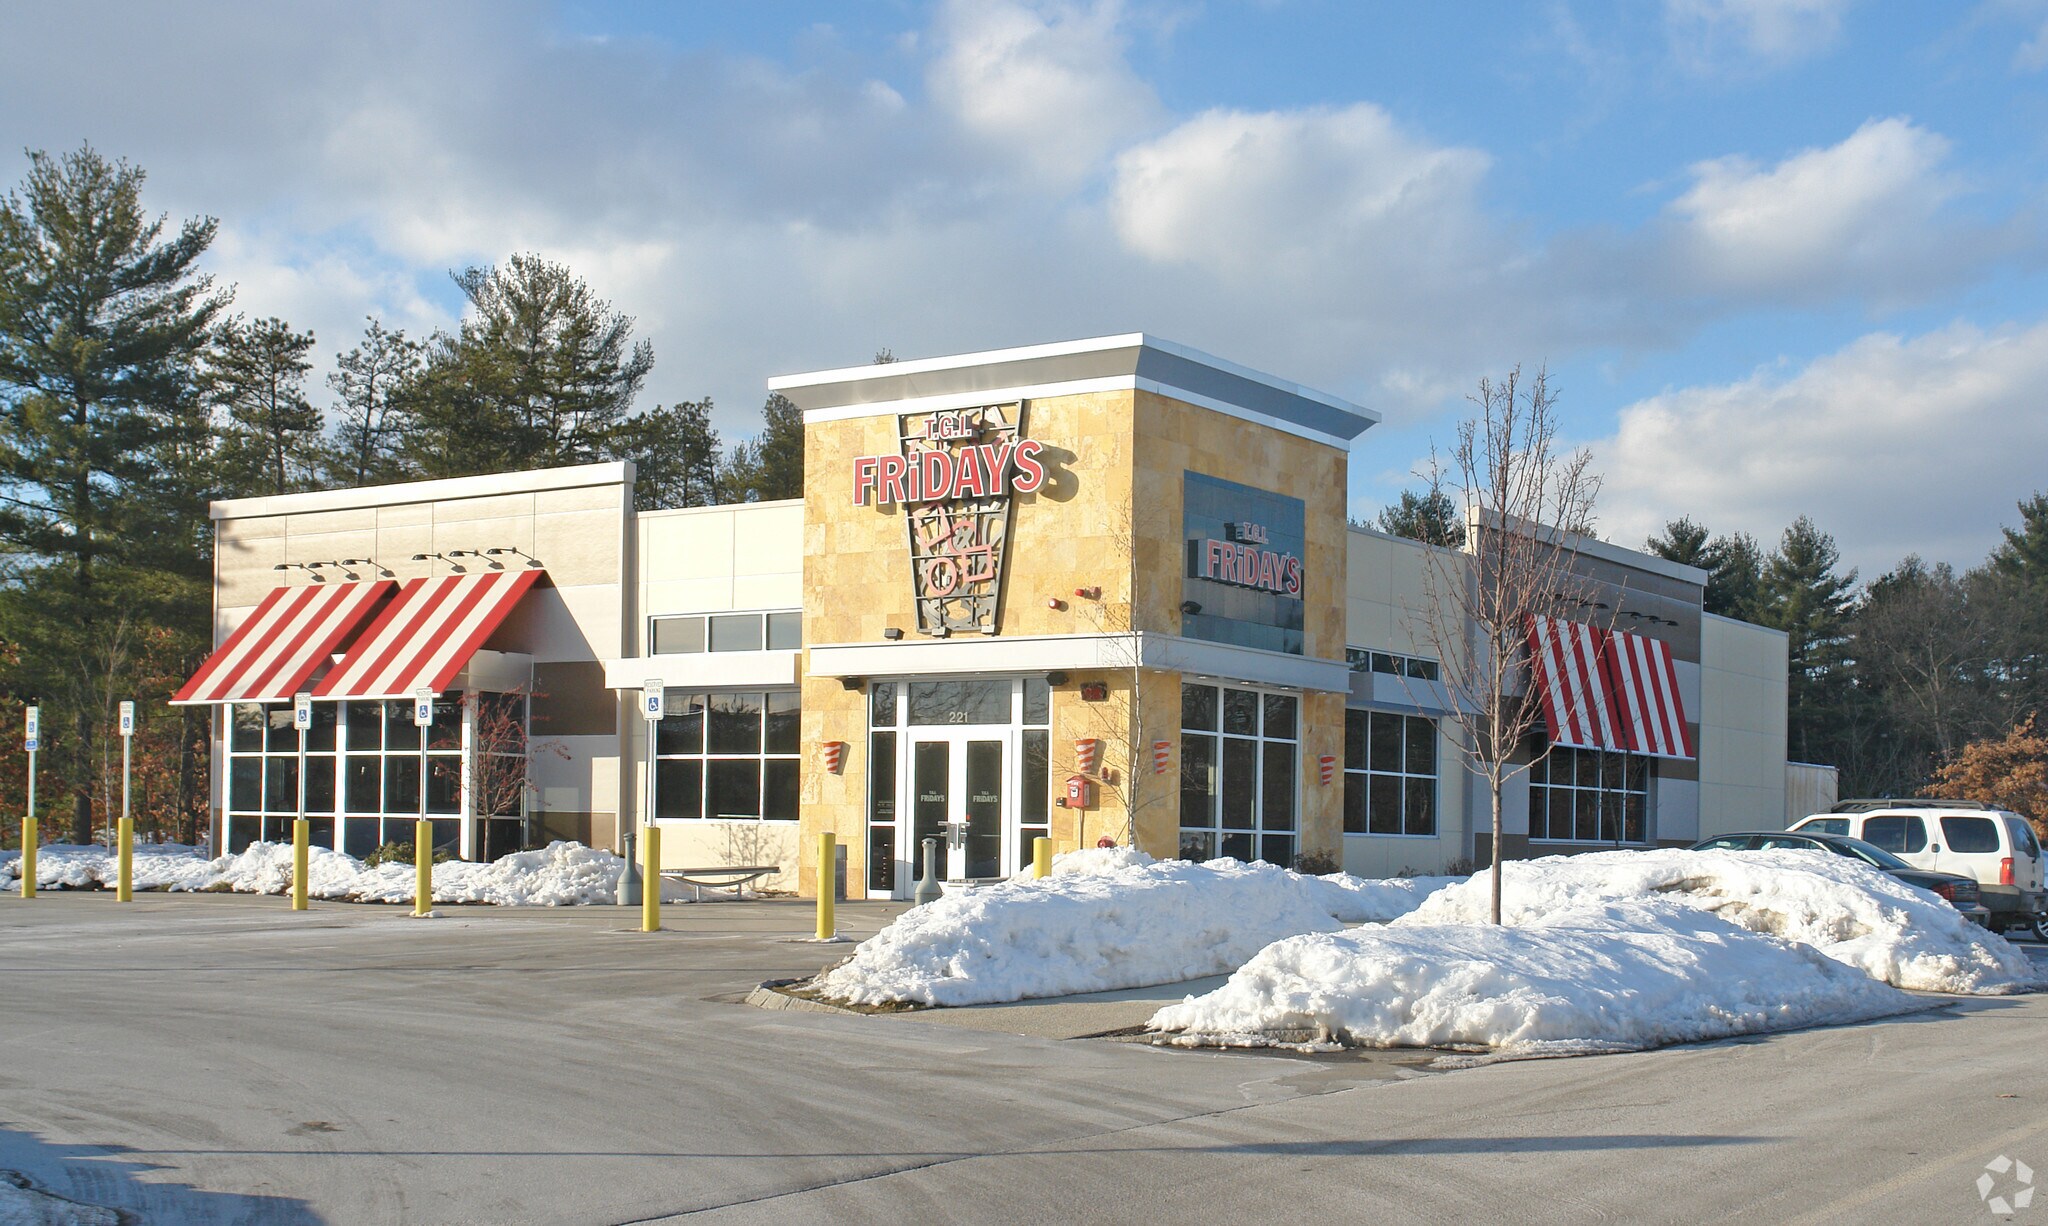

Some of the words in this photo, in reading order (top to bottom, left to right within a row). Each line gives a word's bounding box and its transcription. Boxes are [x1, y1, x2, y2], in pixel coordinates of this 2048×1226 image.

[924, 415, 972, 440] T.G.I.
[1243, 522, 1269, 544] T.G.I.
[949, 711, 968, 723] 221
